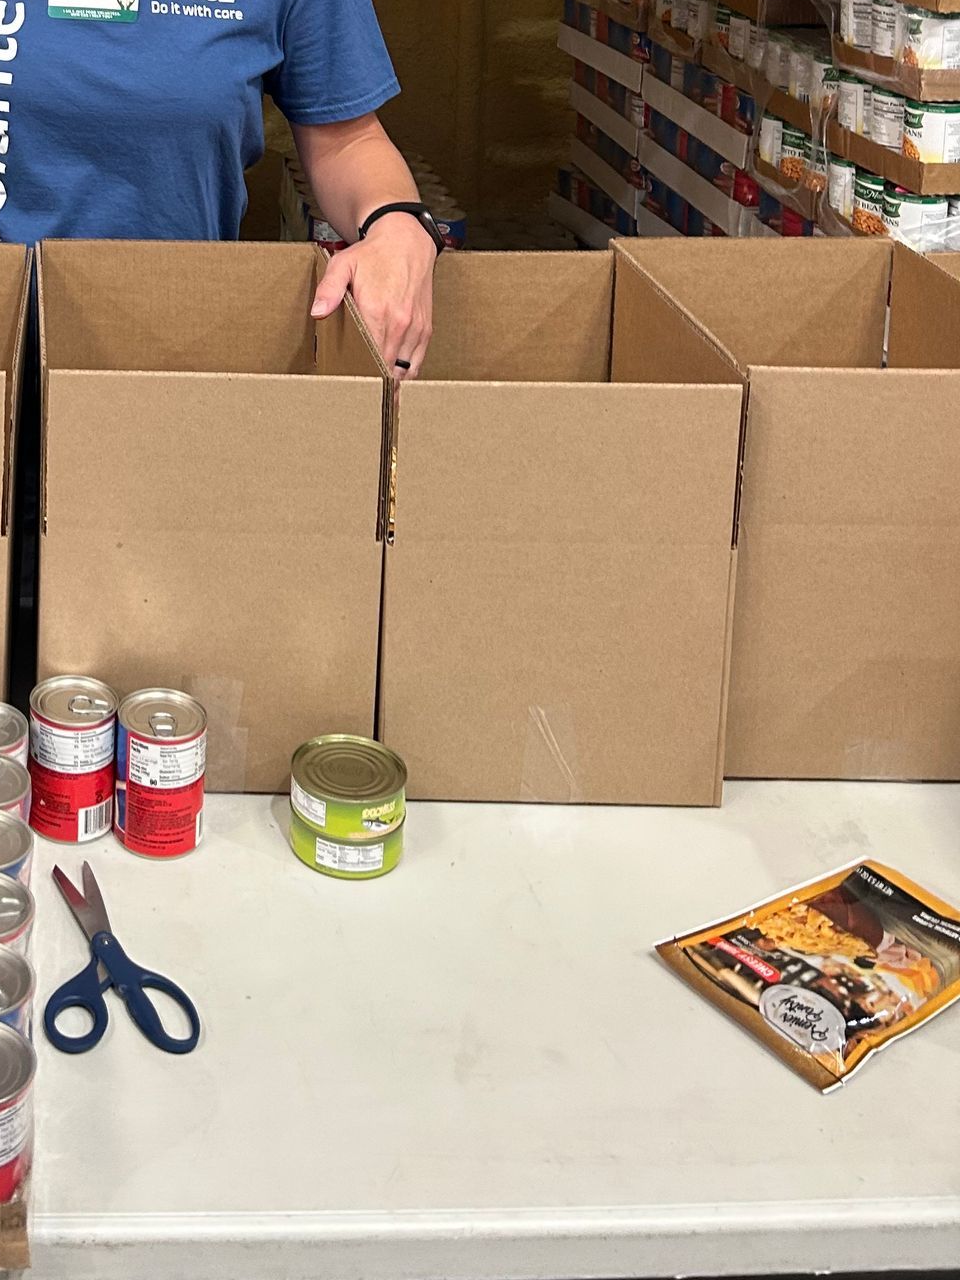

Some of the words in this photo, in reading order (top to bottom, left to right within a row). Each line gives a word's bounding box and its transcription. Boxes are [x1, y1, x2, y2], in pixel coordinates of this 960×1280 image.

[151, 0, 168, 15] Do
[170, 1, 180, 15] it
[181, 3, 212, 18] with
[214, 9, 244, 21] care
[779, 994, 825, 1022] Pantry
[780, 1010, 828, 1042] Premier
